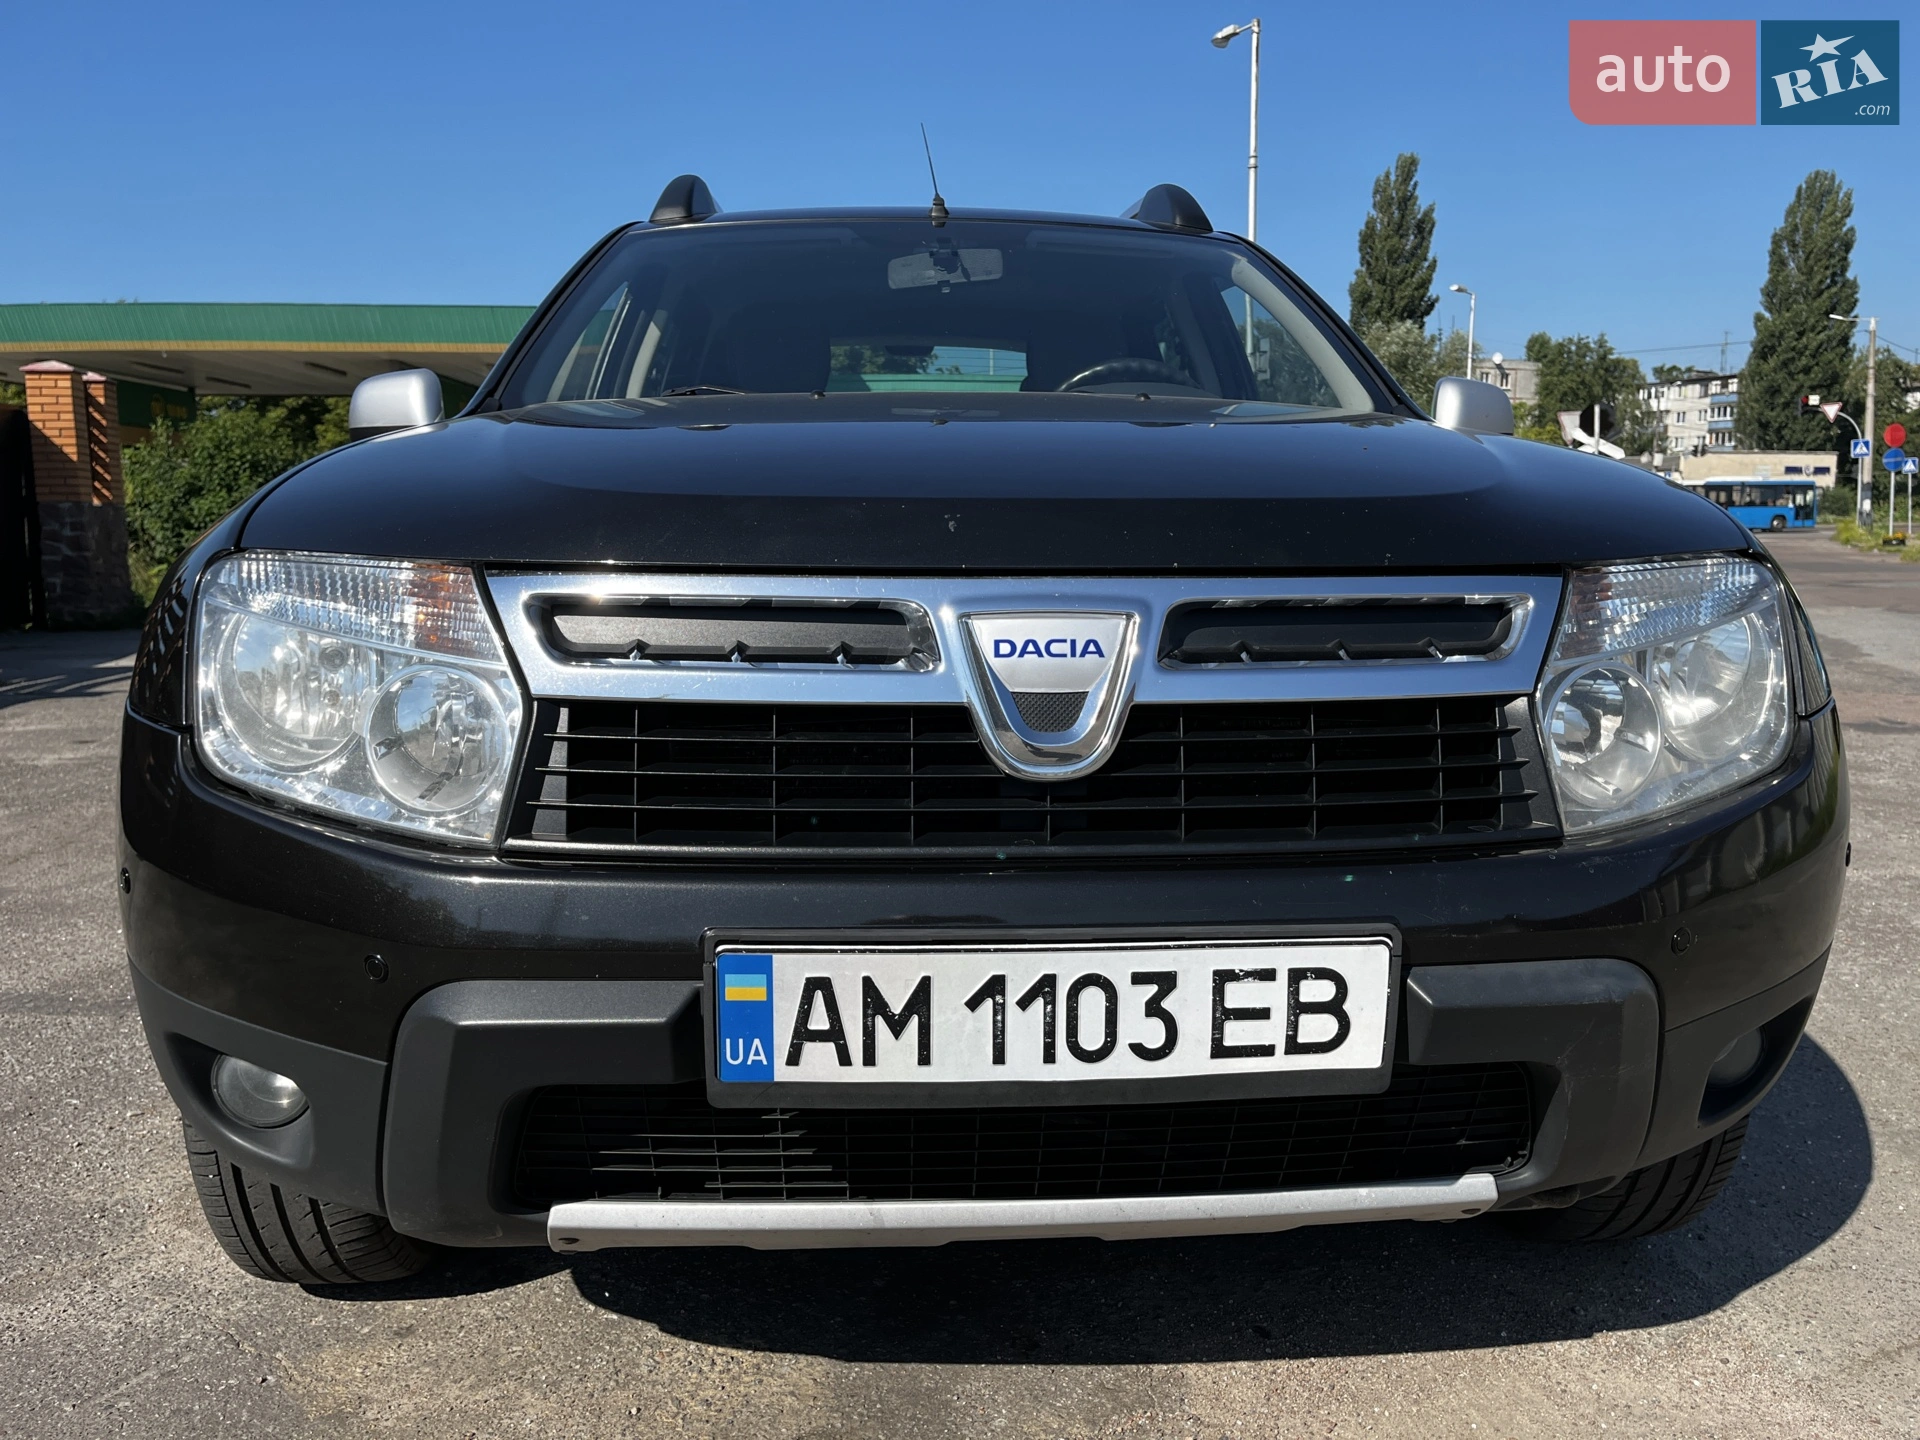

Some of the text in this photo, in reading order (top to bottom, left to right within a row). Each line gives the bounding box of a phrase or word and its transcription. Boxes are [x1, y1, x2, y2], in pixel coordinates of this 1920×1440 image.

[994, 639, 1105, 658] DACIA
[785, 966, 1354, 1067] AM 1103 EB
[725, 1037, 768, 1066] UA
